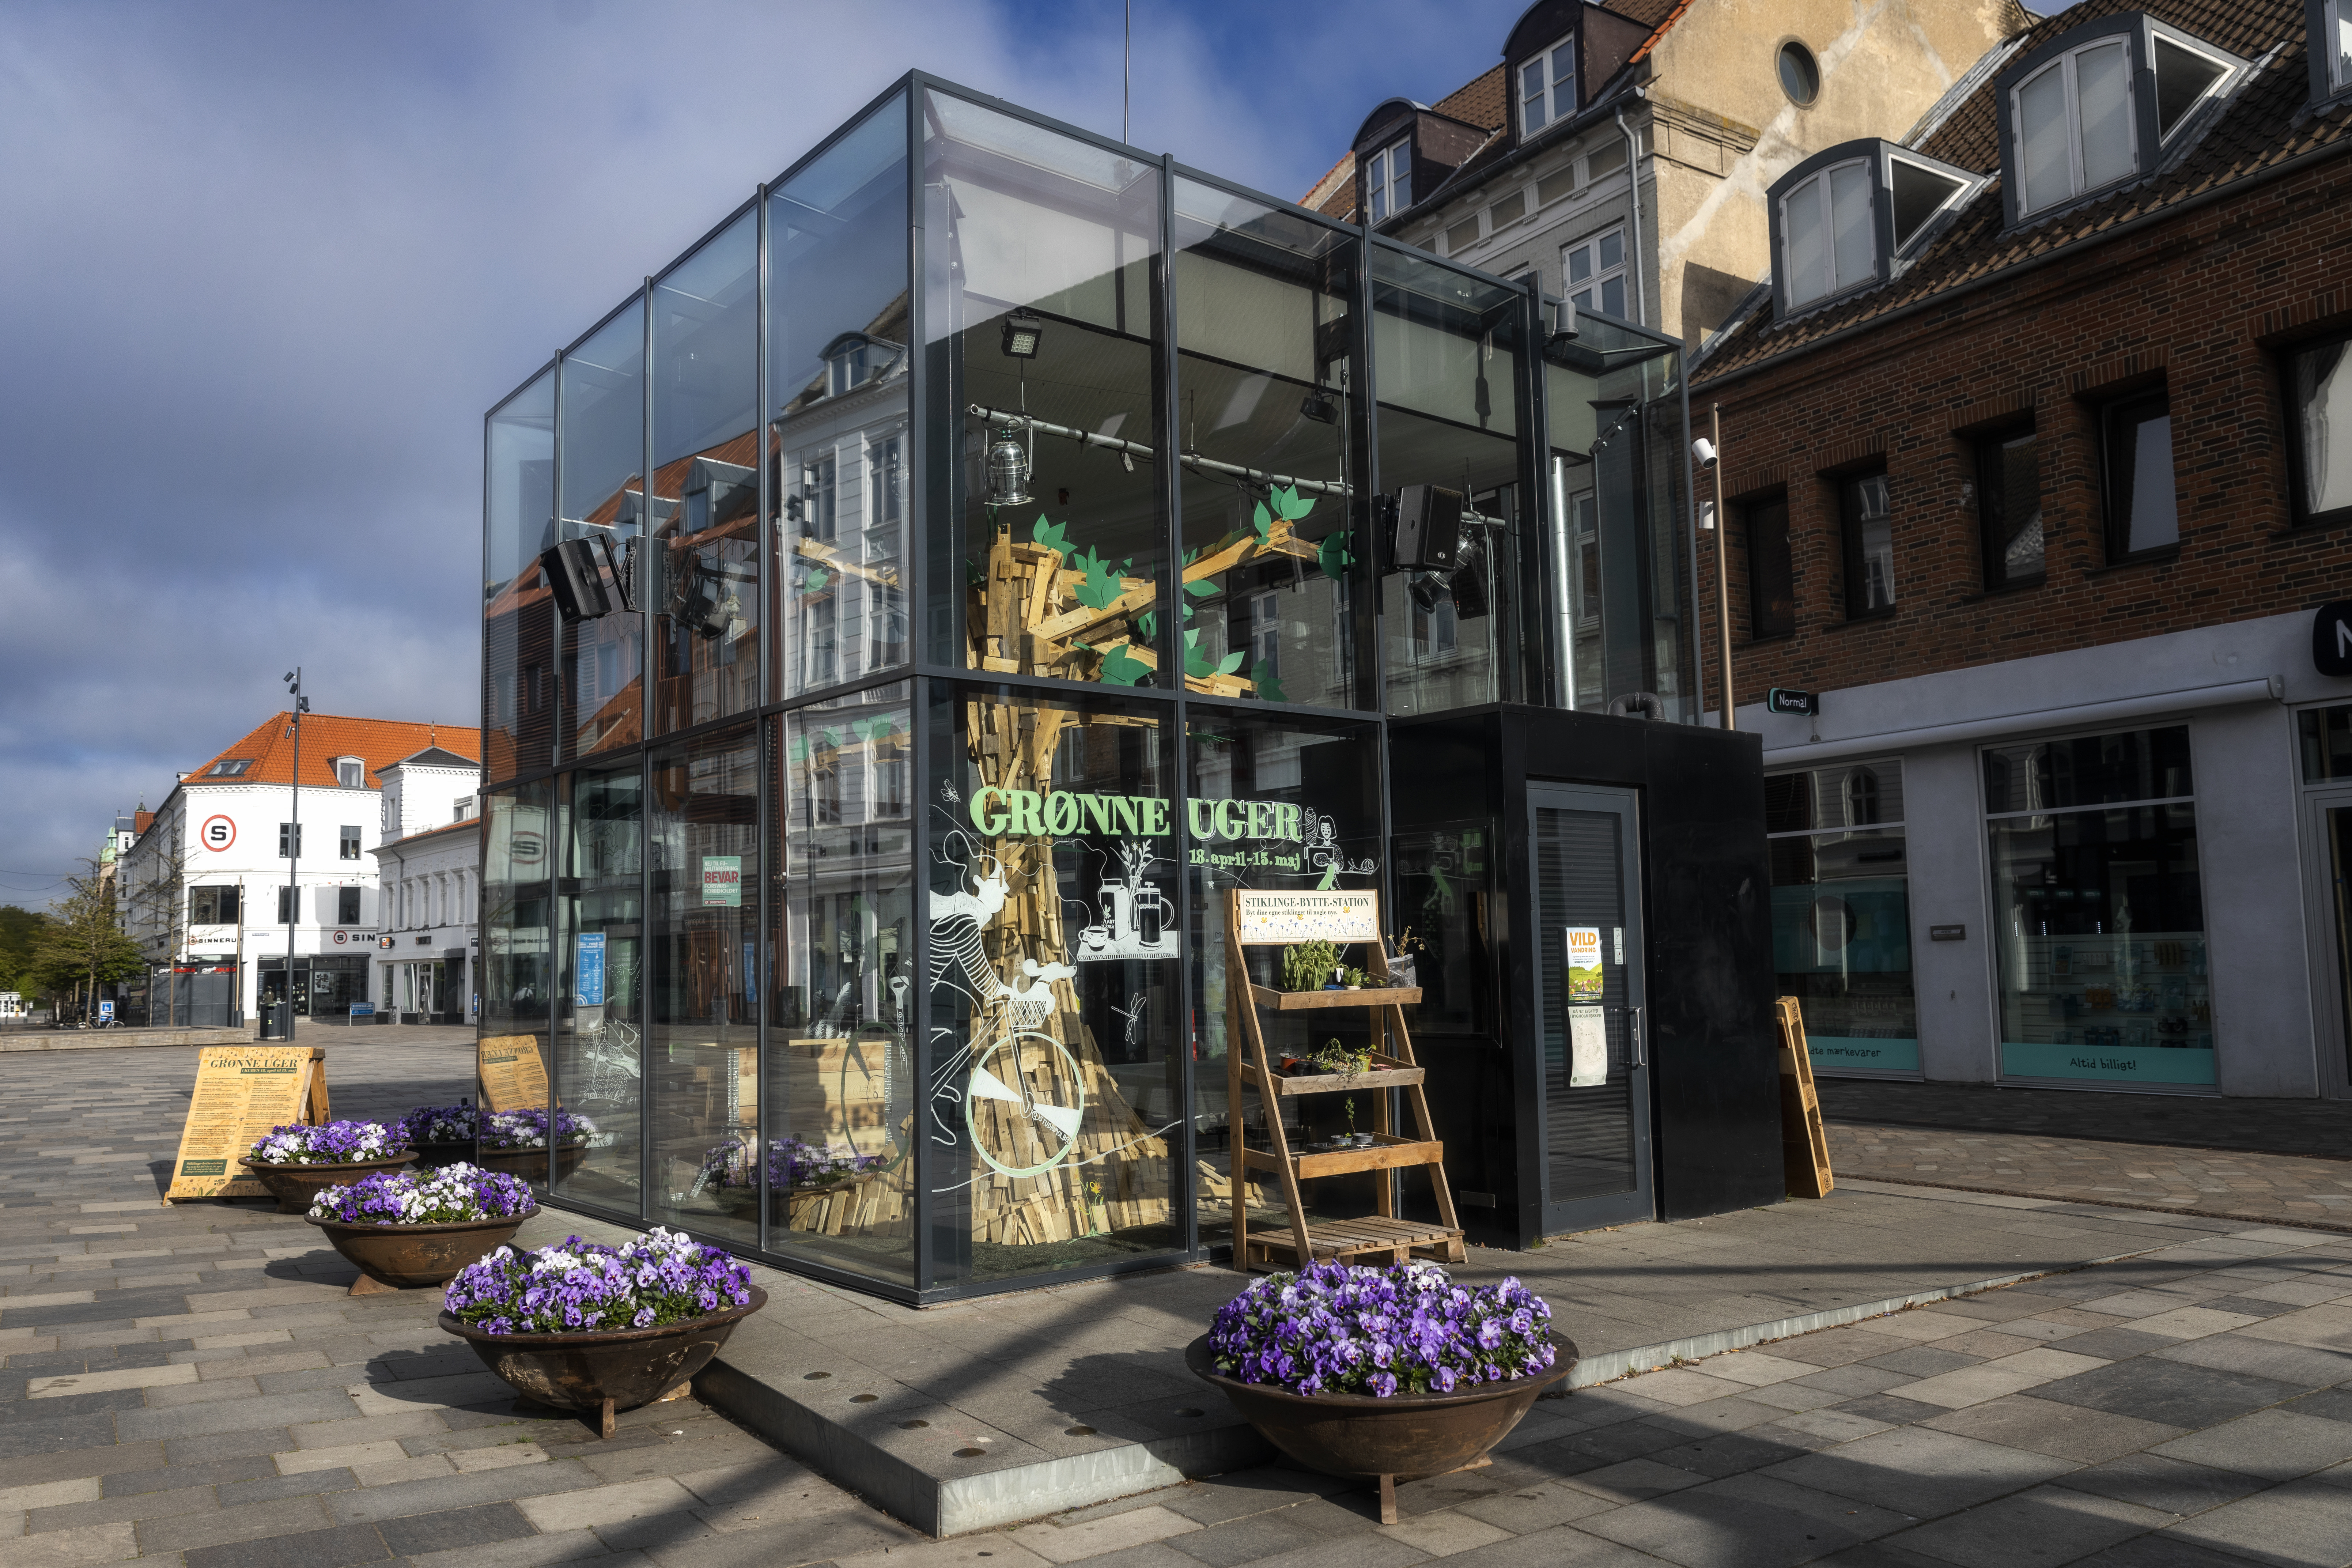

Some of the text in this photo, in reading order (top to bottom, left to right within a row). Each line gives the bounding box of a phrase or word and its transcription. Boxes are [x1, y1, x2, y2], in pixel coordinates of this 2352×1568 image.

[1779, 693, 1807, 708] Normal
[969, 786, 1170, 836] GRØNNE
[1187, 798, 1305, 843] UGER
[211, 825, 227, 840] S
[1189, 849, 1209, 864] 18.
[1275, 853, 1300, 871] maj
[704, 871, 739, 883] BEVAR
[1245, 898, 1369, 907] STIKLINGE-BYTTE-STATION
[685, 917, 706, 926] synoptik
[1570, 932, 1596, 946] VILD
[1827, 1047, 1881, 1057] mærkevarer
[211, 1059, 298, 1068] GRØNNE UGER
[2070, 1057, 2137, 1071] Altid billigt!
